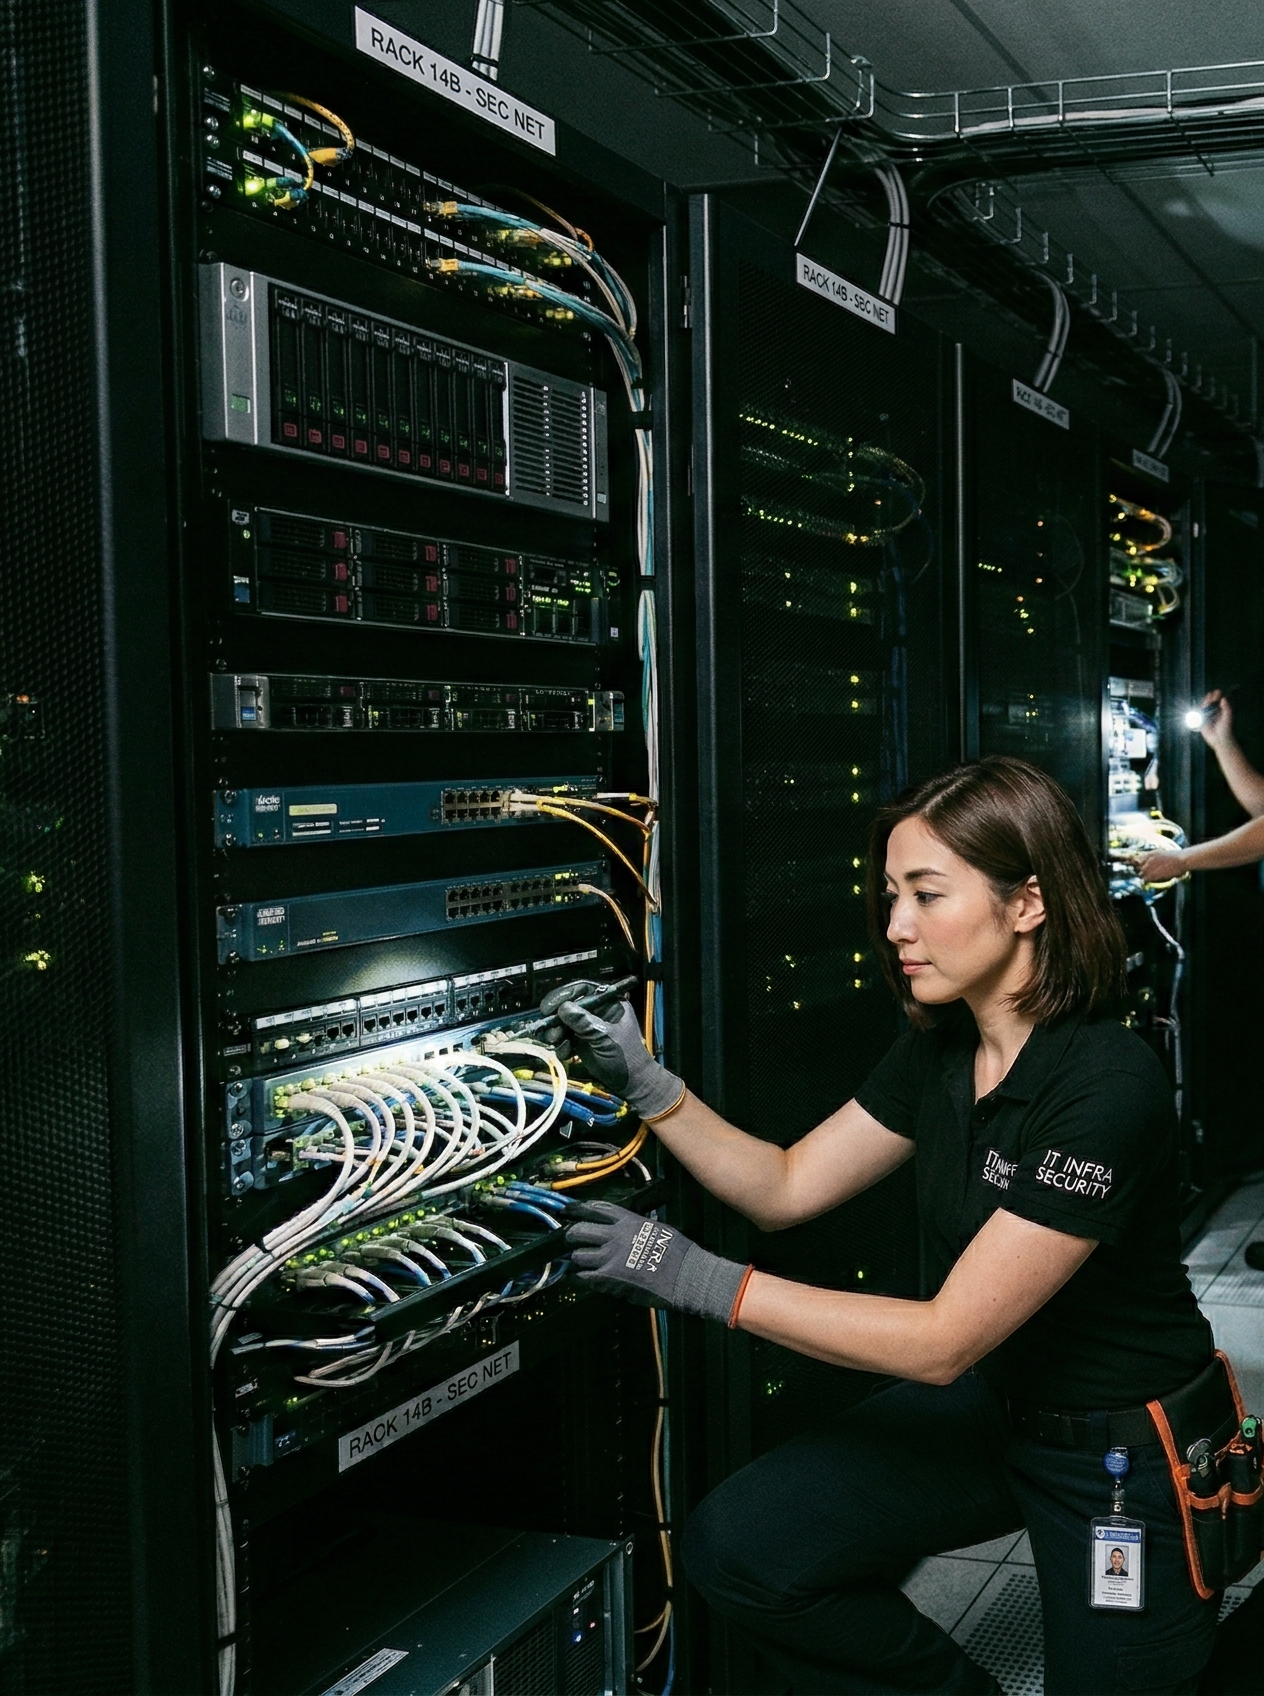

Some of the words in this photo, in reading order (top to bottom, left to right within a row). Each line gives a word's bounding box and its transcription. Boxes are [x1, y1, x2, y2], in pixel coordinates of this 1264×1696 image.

[371, 27, 425, 75] RACK
[430, 63, 461, 93] 14B
[475, 88, 509, 120] SEC
[514, 108, 545, 139] NET
[873, 303, 889, 324] NET
[1036, 1166, 1112, 1199] SECURITY
[1043, 1149, 1061, 1168] IT
[1063, 1156, 1112, 1183] INFRA
[403, 1397, 432, 1425] 14B
[447, 1371, 478, 1401] SEC
[483, 1352, 512, 1382] NET
